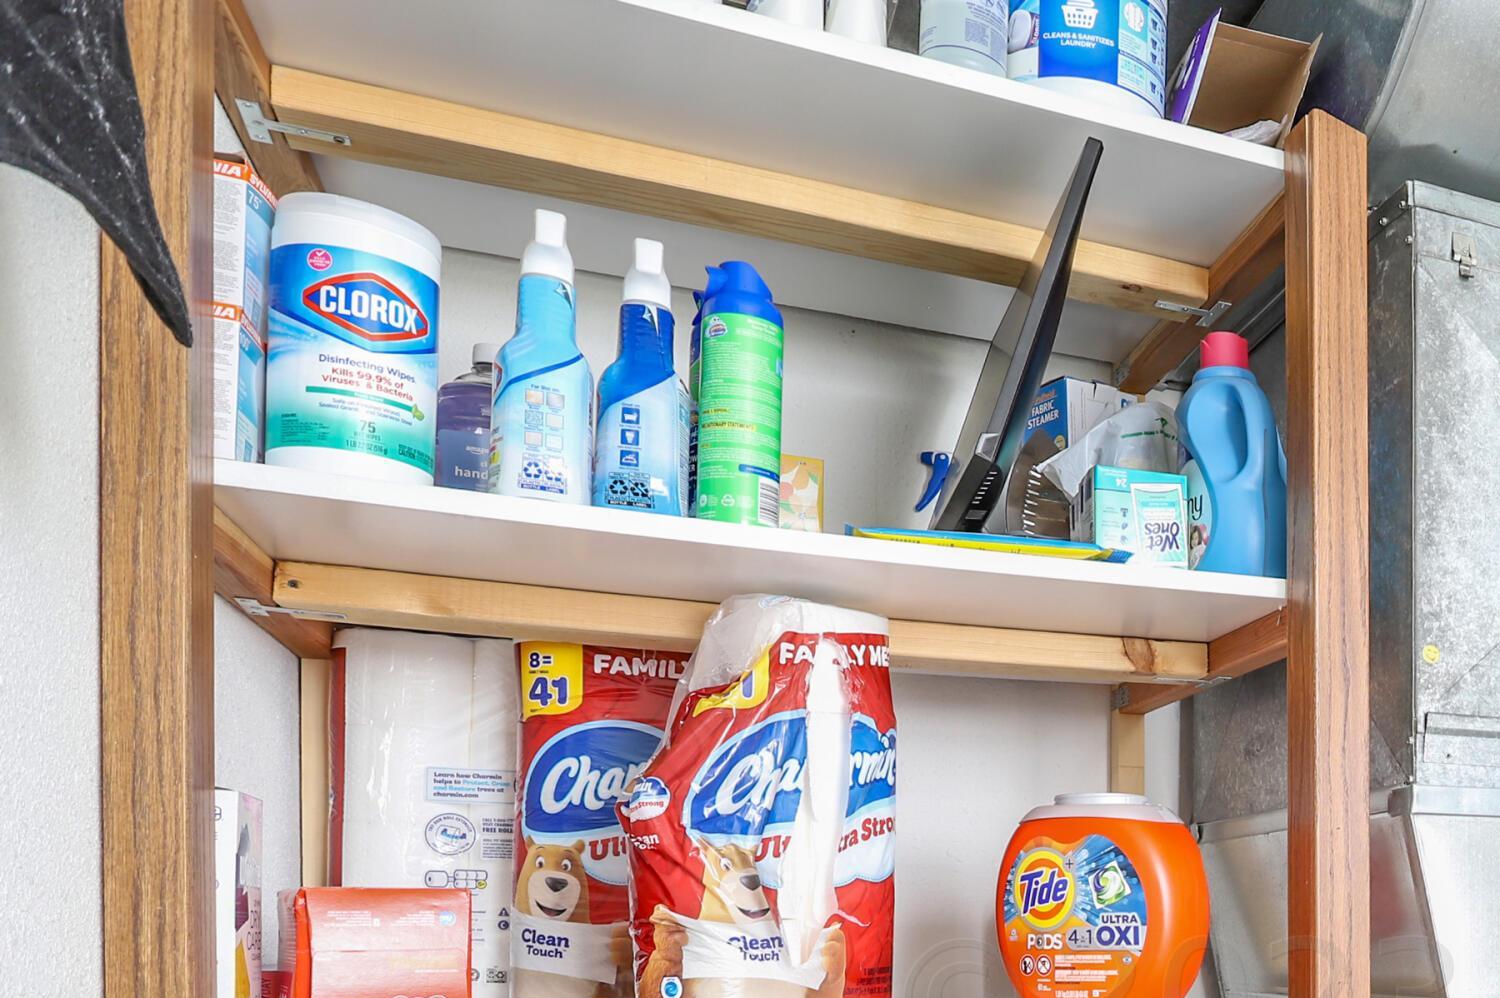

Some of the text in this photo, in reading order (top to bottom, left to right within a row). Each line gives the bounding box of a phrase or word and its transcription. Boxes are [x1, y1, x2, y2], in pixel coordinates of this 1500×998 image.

[1042, 31, 1070, 41] CLEANS
[1078, 33, 1115, 48] SANITIZES
[1060, 38, 1096, 49] LAUNDRY
[319, 284, 419, 335] CLOROX
[319, 353, 416, 384] Disinfecting Wipes
[331, 367, 404, 390] Kills 99.9% of
[321, 374, 360, 387] Viruses
[376, 381, 414, 402] Bacteria
[1031, 399, 1055, 417] FABRIC
[360, 419, 376, 434] 75
[1027, 409, 1060, 430] STEAMER
[454, 465, 489, 480] hand
[1144, 521, 1180, 536] Ones
[1147, 534, 1180, 552] Wet
[528, 676, 569, 707] 41
[1020, 866, 1069, 916] Tide
[1101, 914, 1138, 924] ULTRA
[521, 928, 570, 948] Clean
[728, 933, 784, 951] Clean
[1027, 933, 1063, 950] PODS
[1096, 925, 1141, 946] OXI
[526, 944, 564, 959] Touch
